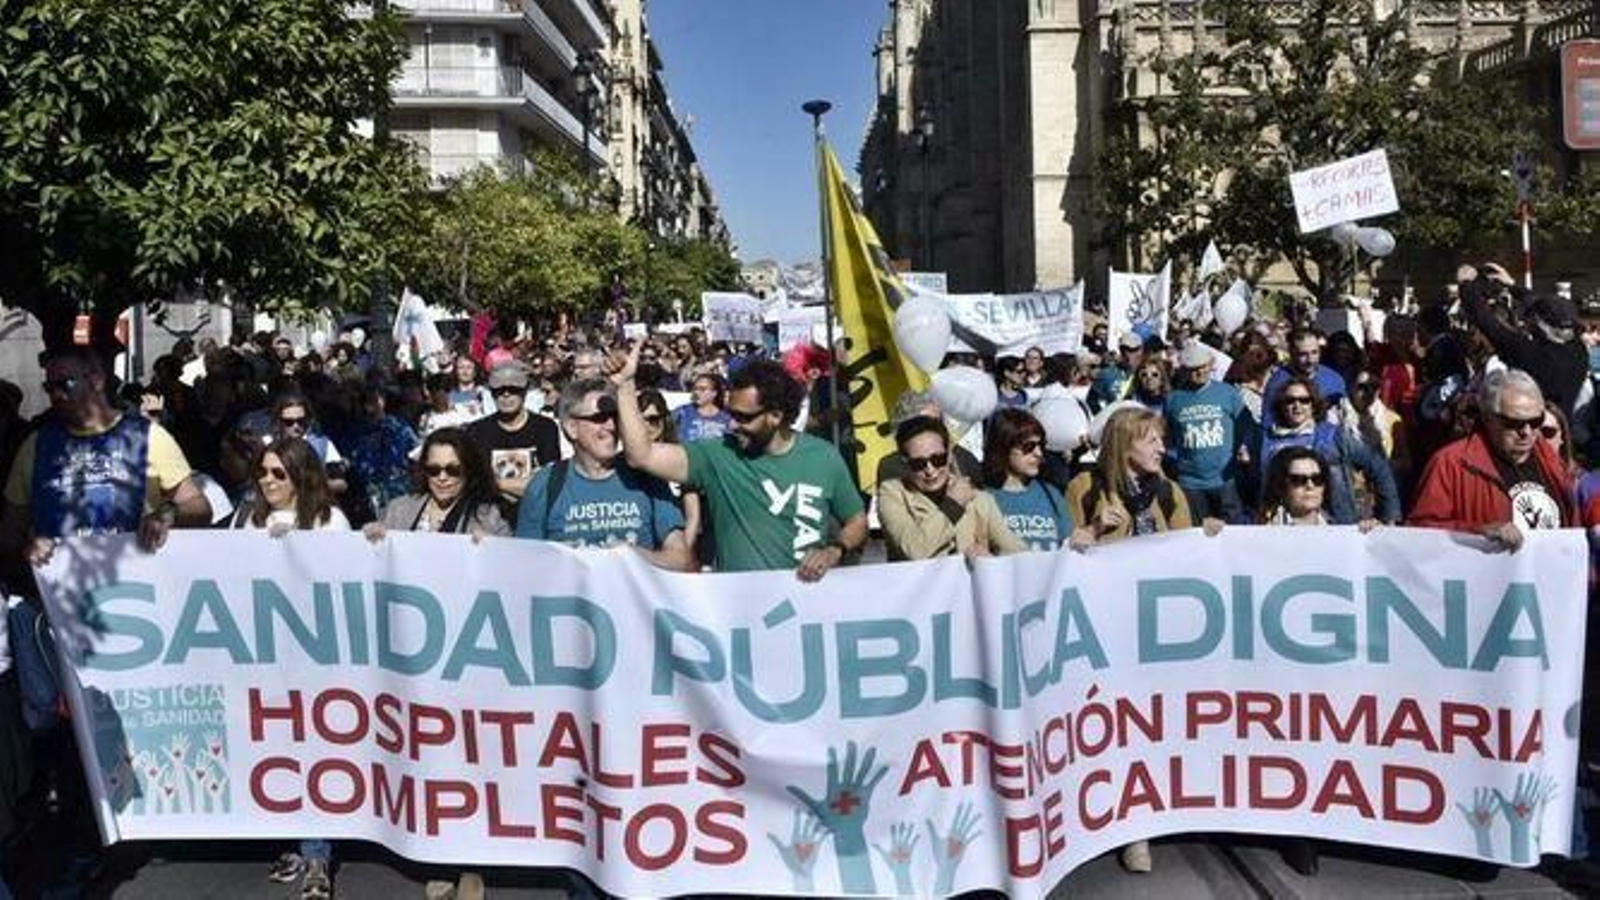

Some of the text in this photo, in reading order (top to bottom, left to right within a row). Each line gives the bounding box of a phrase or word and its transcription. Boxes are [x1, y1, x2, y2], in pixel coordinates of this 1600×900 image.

[974, 293, 1073, 325] SEVILLA
[565, 501, 641, 521] JUSTICIA
[591, 518, 642, 531] SANIDAD
[1003, 514, 1056, 530] STICIA
[82, 574, 1550, 724] SANIDAD PÚBLICA DIGNA
[109, 685, 226, 711] USTICIA
[142, 708, 223, 728] SANIDAD
[249, 687, 746, 789] HOSPITALES
[899, 684, 1545, 799] ATENCIÓN PRIMARIA
[249, 756, 748, 871] COMPLETOS
[1006, 754, 1446, 878] DE CALIDAD
